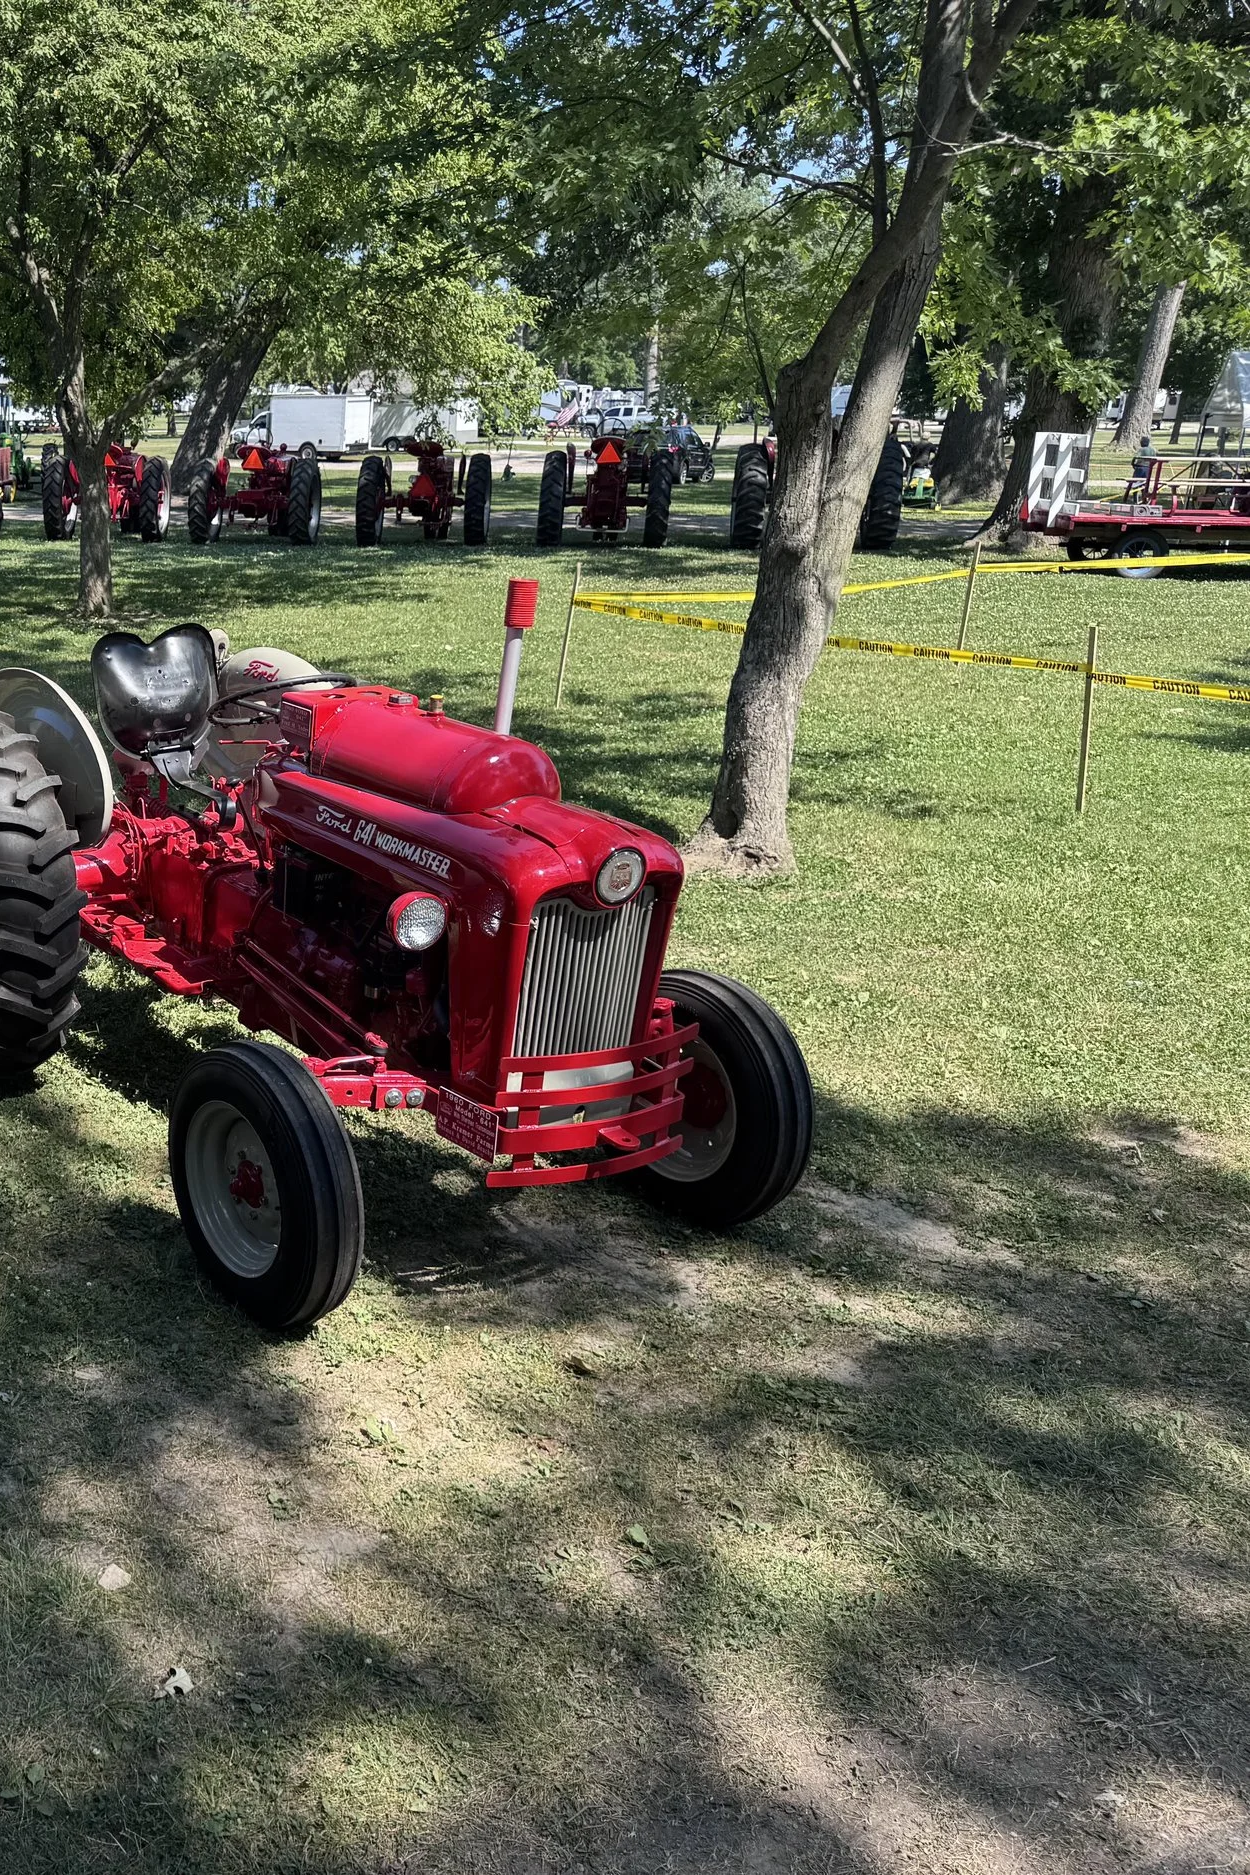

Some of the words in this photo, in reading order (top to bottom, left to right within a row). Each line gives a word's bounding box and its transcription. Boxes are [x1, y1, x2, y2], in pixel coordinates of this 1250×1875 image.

[639, 609, 663, 622] CAUTION
[677, 616, 702, 628] CAUTION
[717, 622, 745, 634] CAUTION
[859, 641, 893, 653] CAUTION
[913, 647, 950, 660] CAUTION
[972, 653, 1012, 665] CAUTION
[1153, 680, 1200, 695] CAUTION
[243, 660, 280, 682] Ford
[316, 805, 352, 833] Ford
[353, 820, 377, 846] 641
[374, 831, 452, 879] WORKMASTER
[445, 1092, 464, 1106] 1960
[469, 1104, 492, 1120] FORD
[455, 1104, 474, 1119] Model
